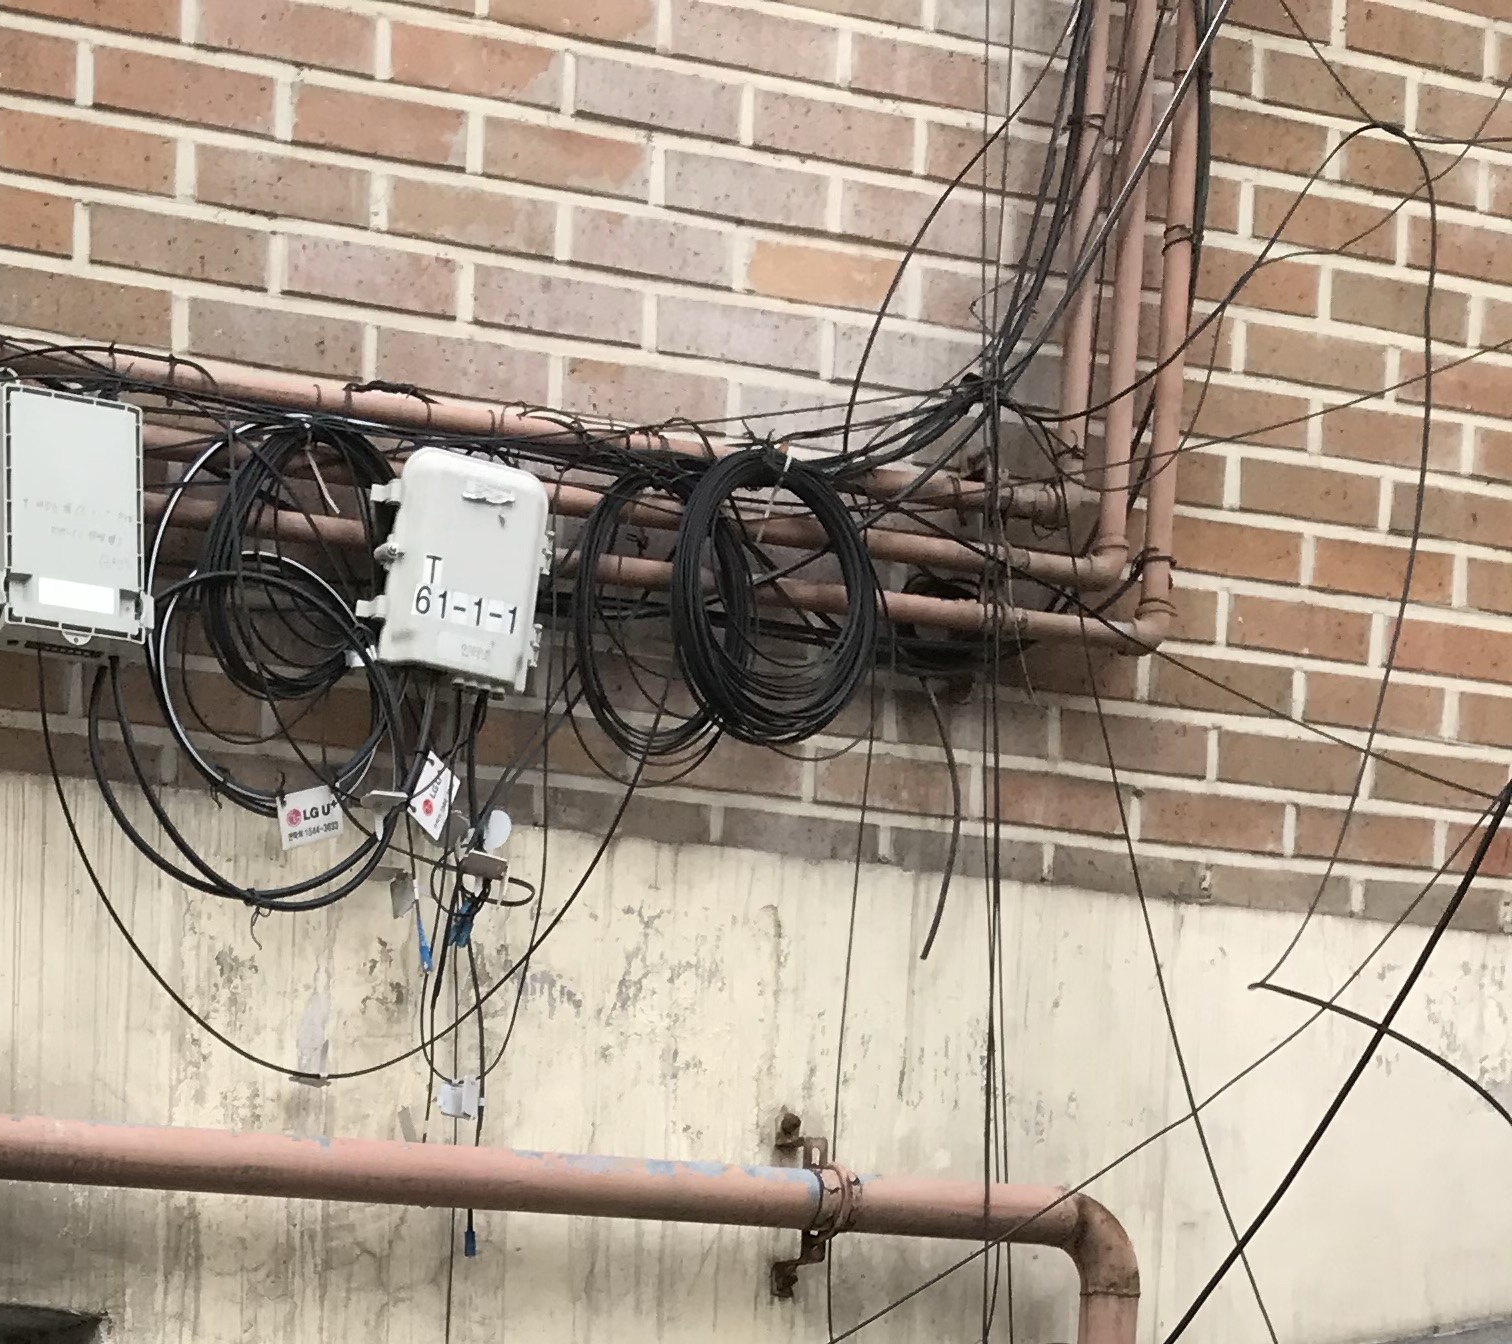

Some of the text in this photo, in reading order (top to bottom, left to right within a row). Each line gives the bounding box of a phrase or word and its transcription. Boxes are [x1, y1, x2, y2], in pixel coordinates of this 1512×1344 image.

[426, 554, 443, 585] T
[414, 585, 519, 635] 61-1-1
[302, 799, 338, 822] LG U+
